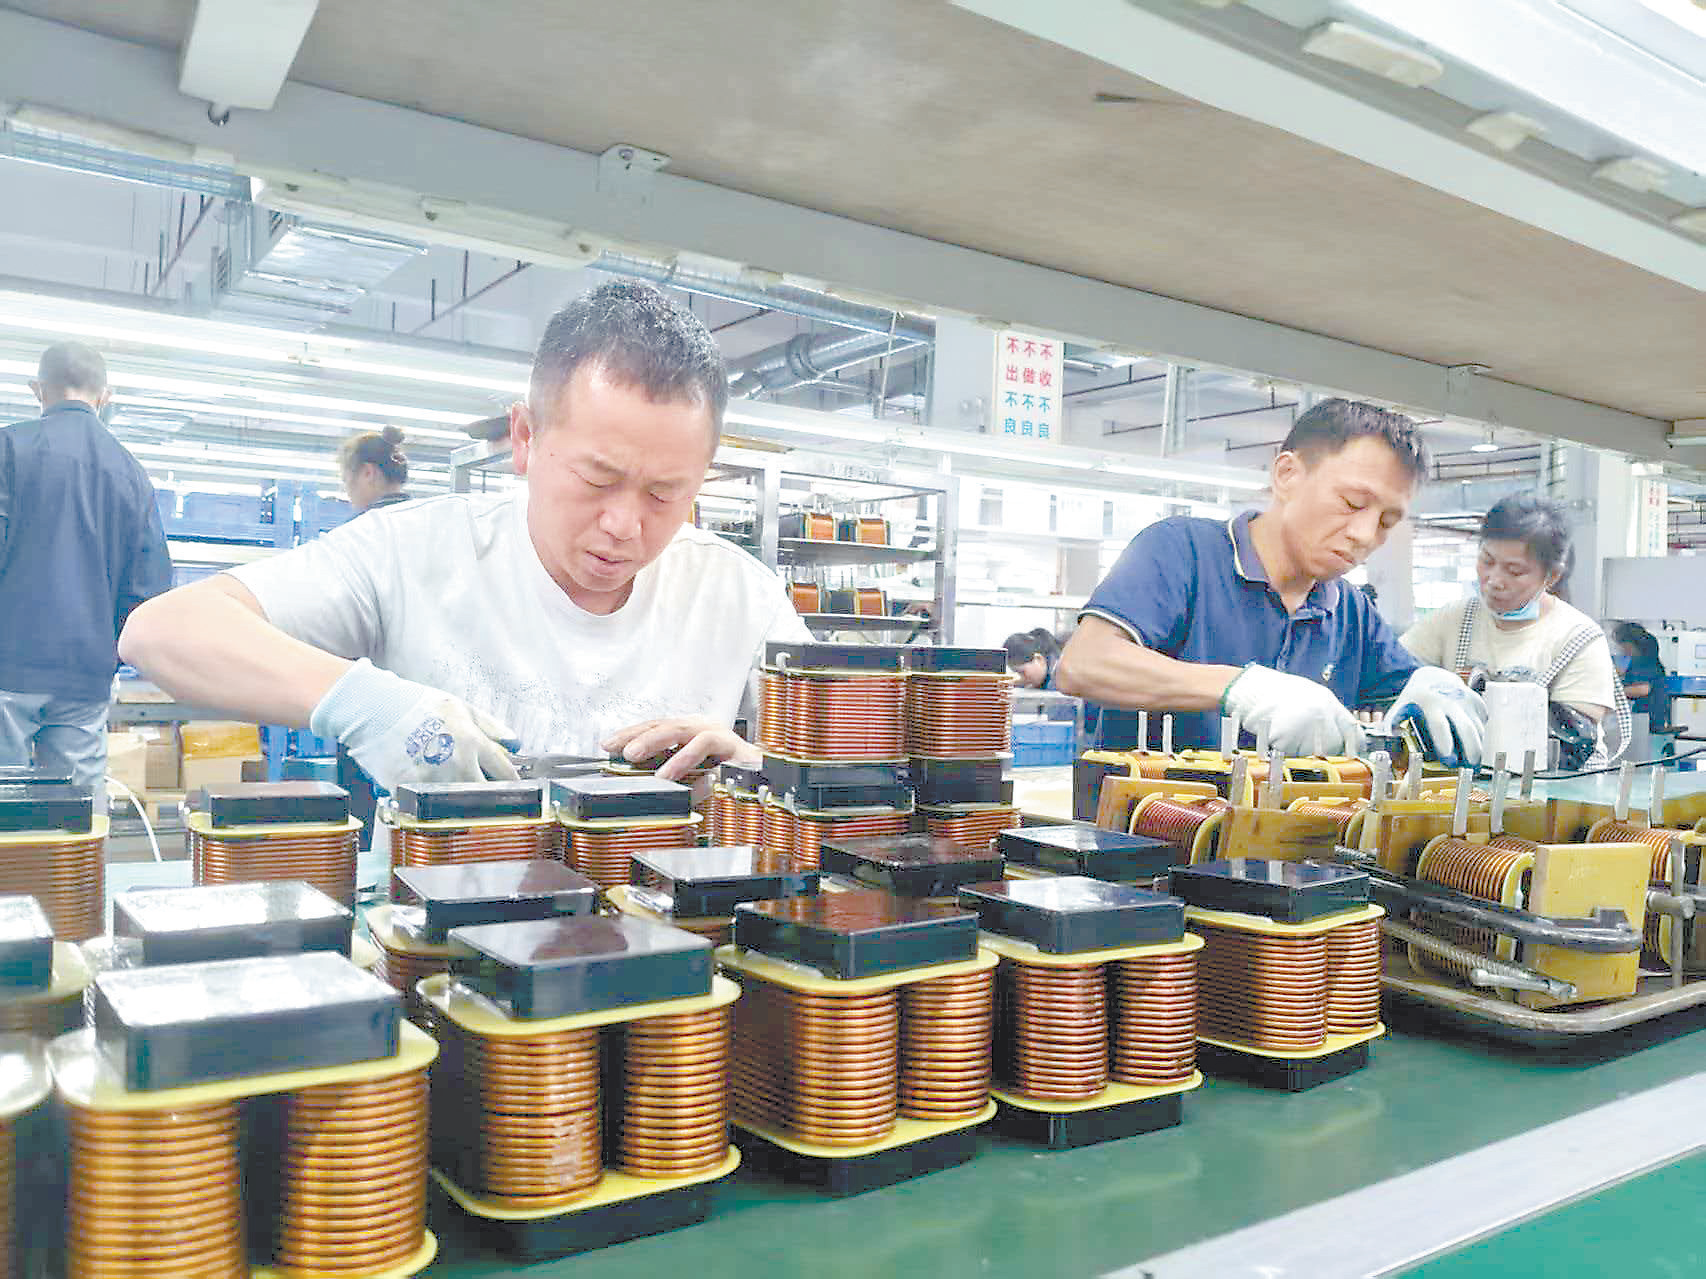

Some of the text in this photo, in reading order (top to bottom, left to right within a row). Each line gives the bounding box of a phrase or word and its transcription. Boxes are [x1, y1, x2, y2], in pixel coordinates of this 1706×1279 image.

[1004, 337, 1019, 434] 不出不良
[1039, 343, 1053, 439] 不收不良
